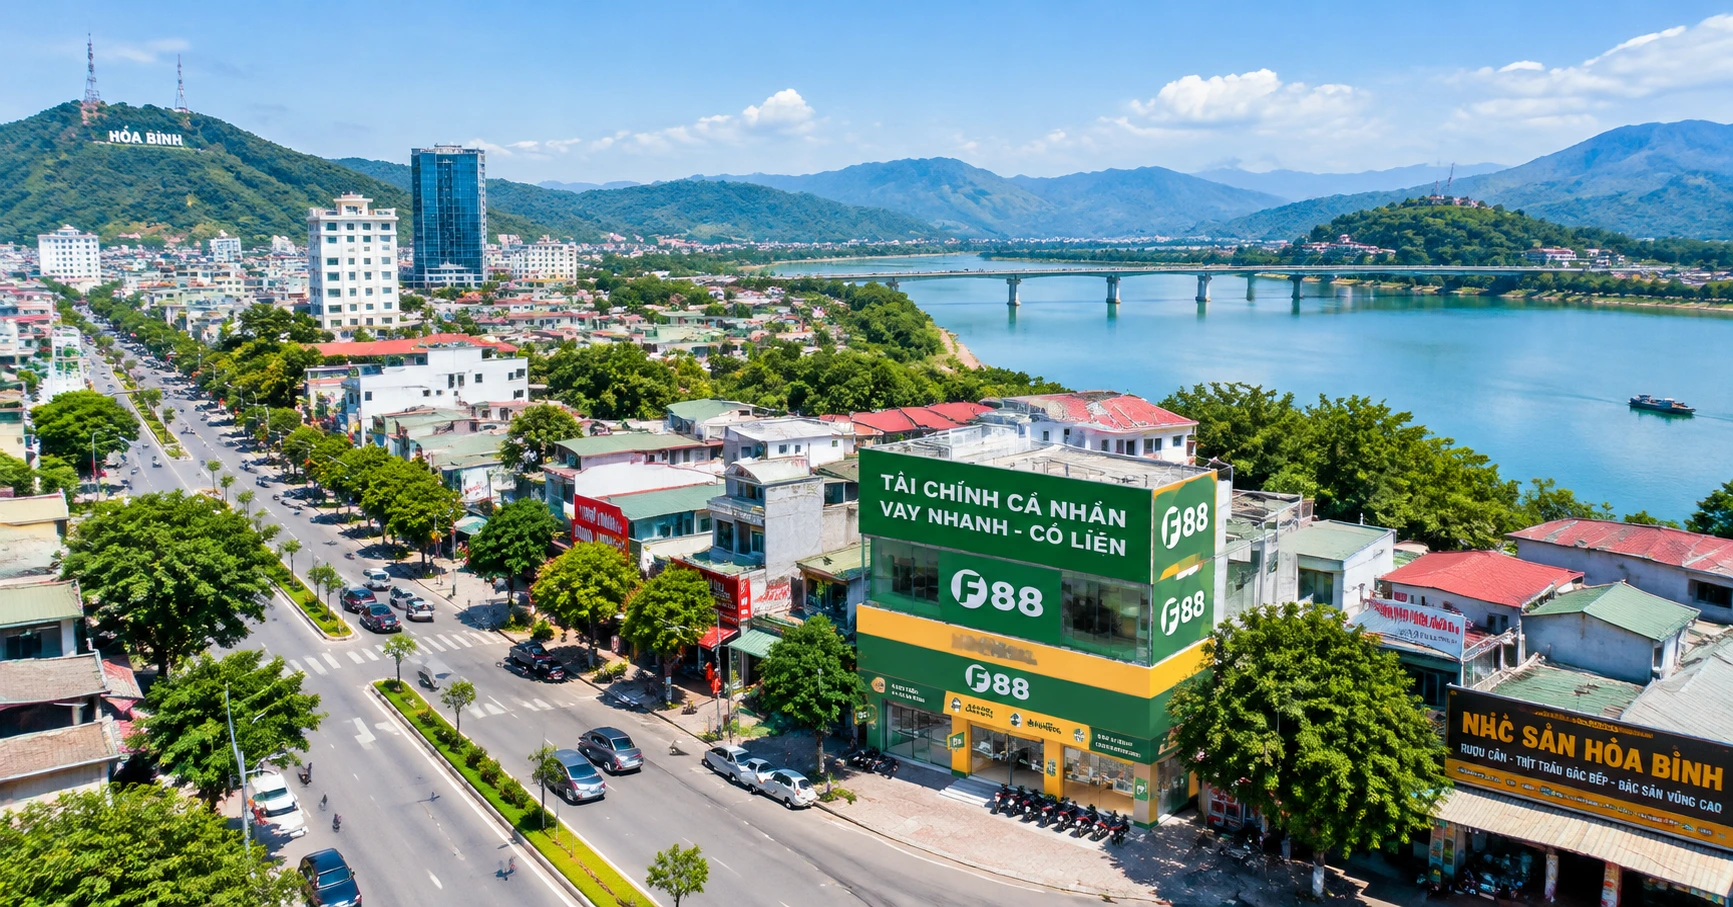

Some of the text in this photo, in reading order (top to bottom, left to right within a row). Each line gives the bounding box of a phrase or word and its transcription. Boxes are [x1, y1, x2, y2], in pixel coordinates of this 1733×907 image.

[880, 500, 921, 521] VAY
[928, 507, 1008, 536] NHANH
[1161, 502, 1208, 549] F88
[951, 569, 1044, 617] F88
[1160, 590, 1205, 636] F88
[965, 664, 1030, 700] F88
